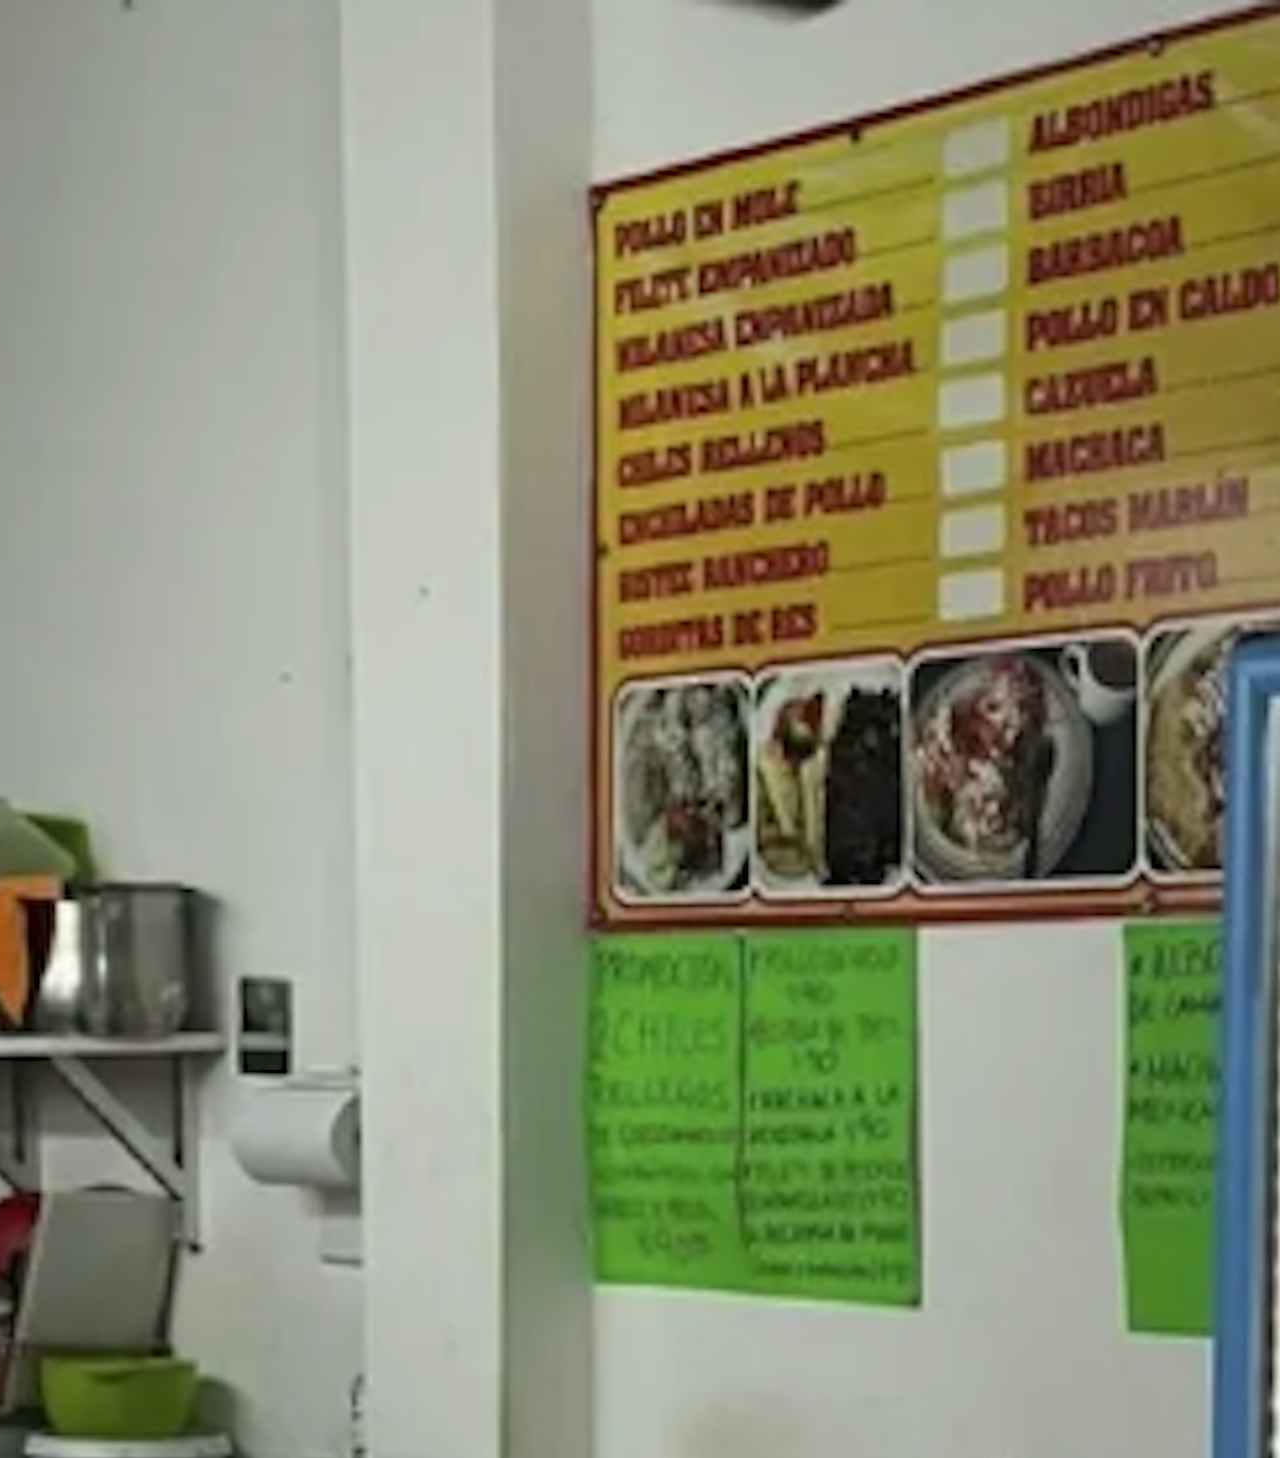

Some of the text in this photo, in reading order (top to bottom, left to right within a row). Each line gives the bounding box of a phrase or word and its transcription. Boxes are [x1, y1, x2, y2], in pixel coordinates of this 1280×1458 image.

[615, 179, 801, 259] POLLO EN MOLE
[1026, 296, 1118, 352] POLLO
[1128, 285, 1170, 332] EN
[739, 371, 756, 409] A
[760, 361, 788, 404] LA
[1025, 420, 1166, 483] MACHACA
[764, 485, 796, 524] DE
[803, 471, 887, 518] POLLO
[1024, 498, 1119, 547] TACOS
[1024, 562, 1116, 614] POLLO
[732, 609, 763, 646] DE
